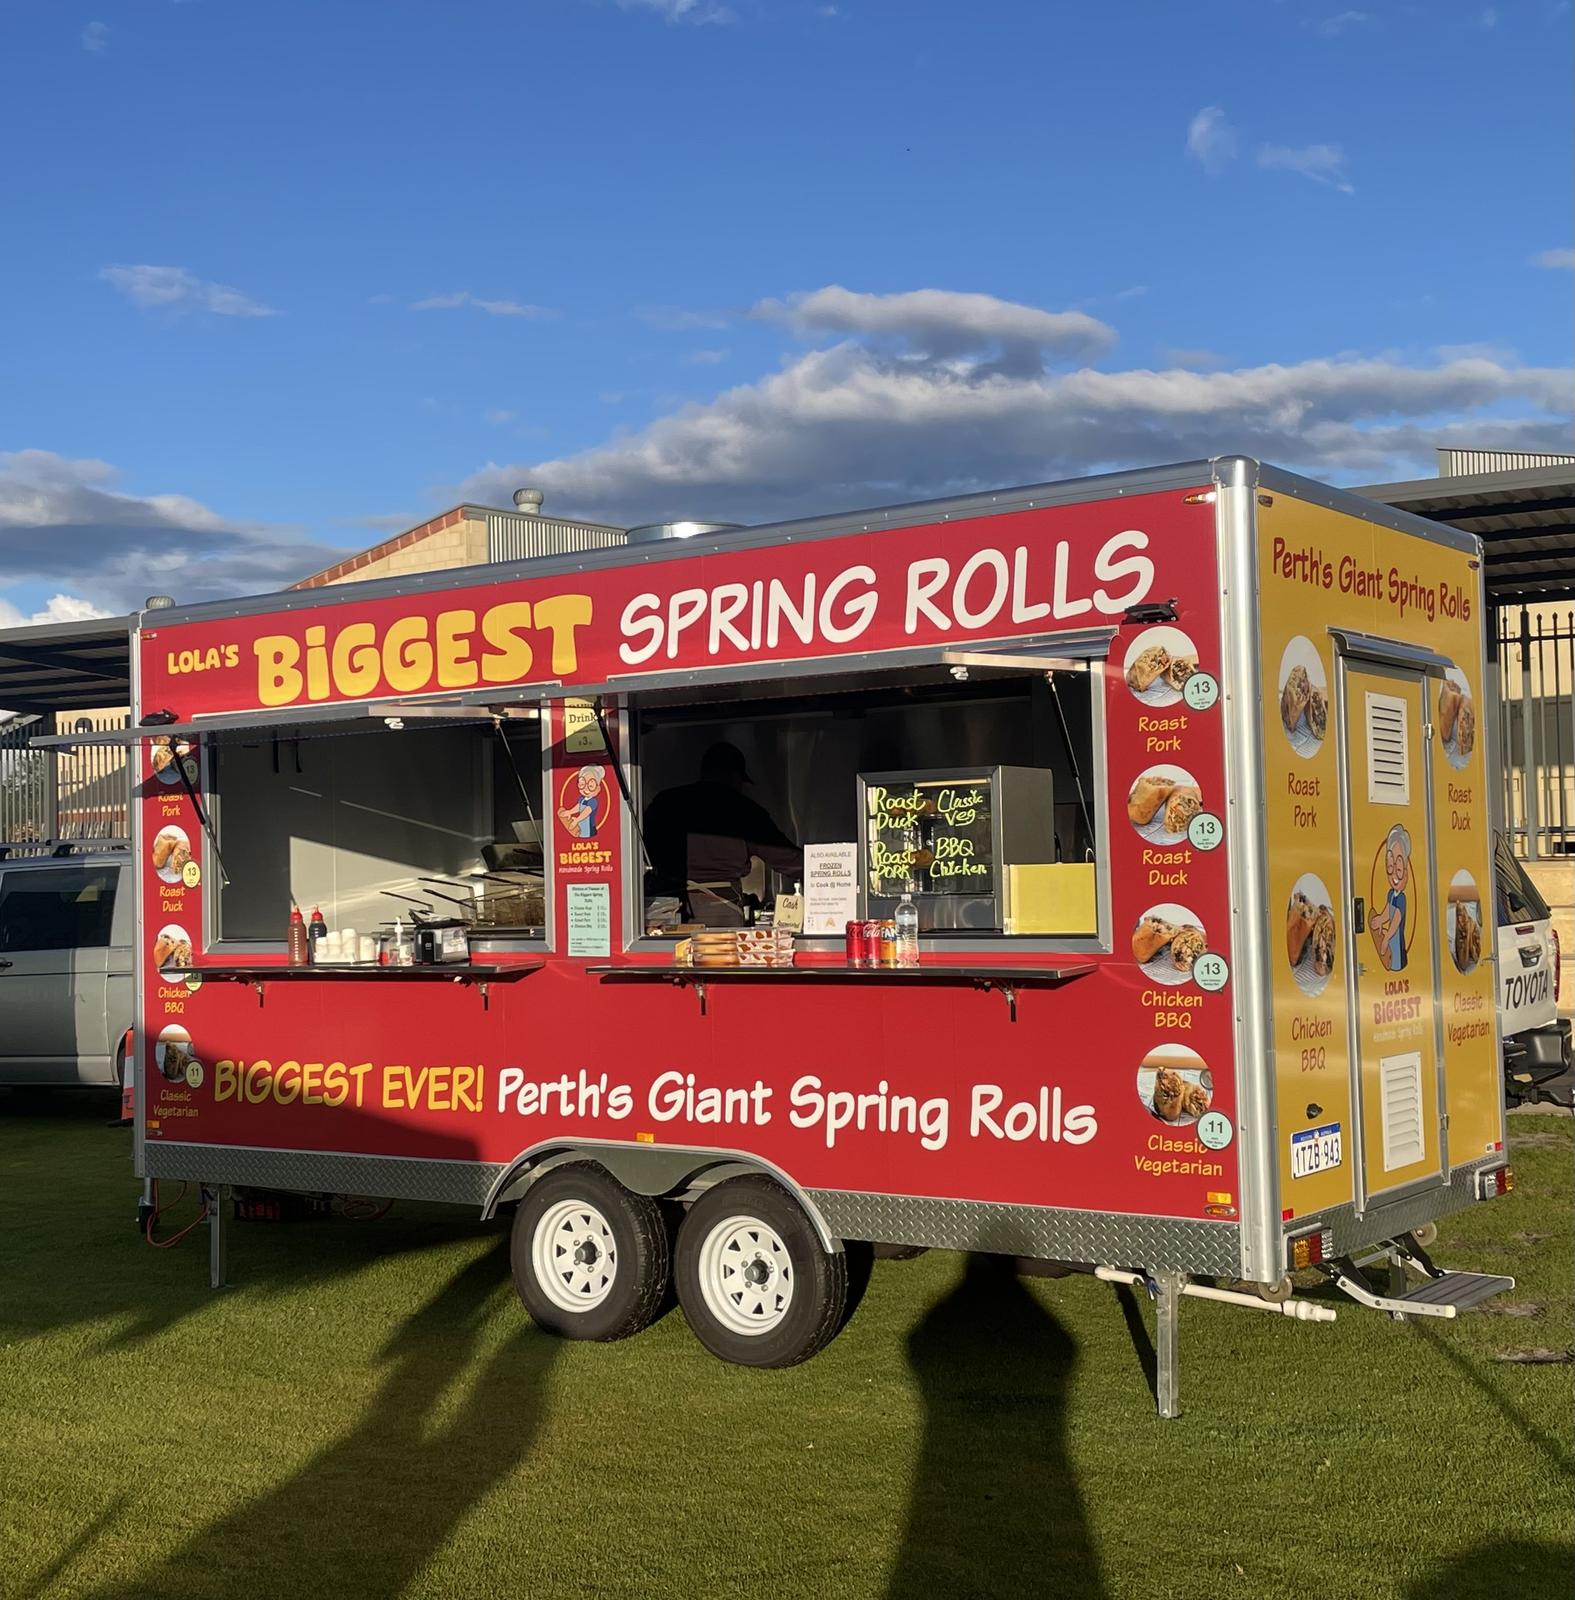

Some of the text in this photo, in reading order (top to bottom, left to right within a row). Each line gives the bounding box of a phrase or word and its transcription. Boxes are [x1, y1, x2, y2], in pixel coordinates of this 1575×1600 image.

[1273, 537, 1470, 622] Perth's Giant Spring Rolls
[167, 643, 239, 675] LOLA'S
[618, 564, 879, 665] SPRING
[904, 530, 1155, 635] ROLLS
[1138, 715, 1188, 733] Roast
[1146, 735, 1182, 752] Pork
[1288, 772, 1320, 797] Roast
[1448, 783, 1472, 803] Roast
[876, 787, 926, 811] Roast
[937, 789, 983, 812] Classic
[162, 805, 181, 816] Pork
[945, 809, 976, 826] Veg
[1294, 805, 1317, 828] Pork
[876, 812, 918, 829] Duck
[1451, 811, 1471, 831] Duck
[571, 841, 599, 851] LOLA'S
[875, 841, 916, 865] Roast
[935, 837, 974, 859] BBQ
[1142, 849, 1192, 865] Roast
[930, 858, 987, 877] Chicken
[1148, 869, 1188, 886] Duck
[159, 885, 186, 897] Roast
[162, 900, 184, 912] Duck
[881, 927, 897, 938] FAN
[158, 986, 192, 998] Chicken
[1384, 979, 1409, 996] LOLA'S
[1505, 969, 1548, 1010] TOYOTA
[164, 1002, 185, 1014] BBQ
[1141, 990, 1203, 1007] Chicken
[1453, 991, 1483, 1013] Classic
[1154, 1012, 1192, 1029] BBQ
[1291, 1015, 1332, 1041] Chicken
[1447, 1018, 1490, 1046] Vegetarian
[1301, 1046, 1326, 1072] BBQ
[160, 1089, 192, 1102] Classic
[153, 1104, 199, 1119] Vegetarian
[214, 1060, 1098, 1151] BIGGEST EVER! Perth's Giant Spring Rolls
[1147, 1134, 1208, 1153] Classic
[1134, 1155, 1223, 1177] Vegetarian
